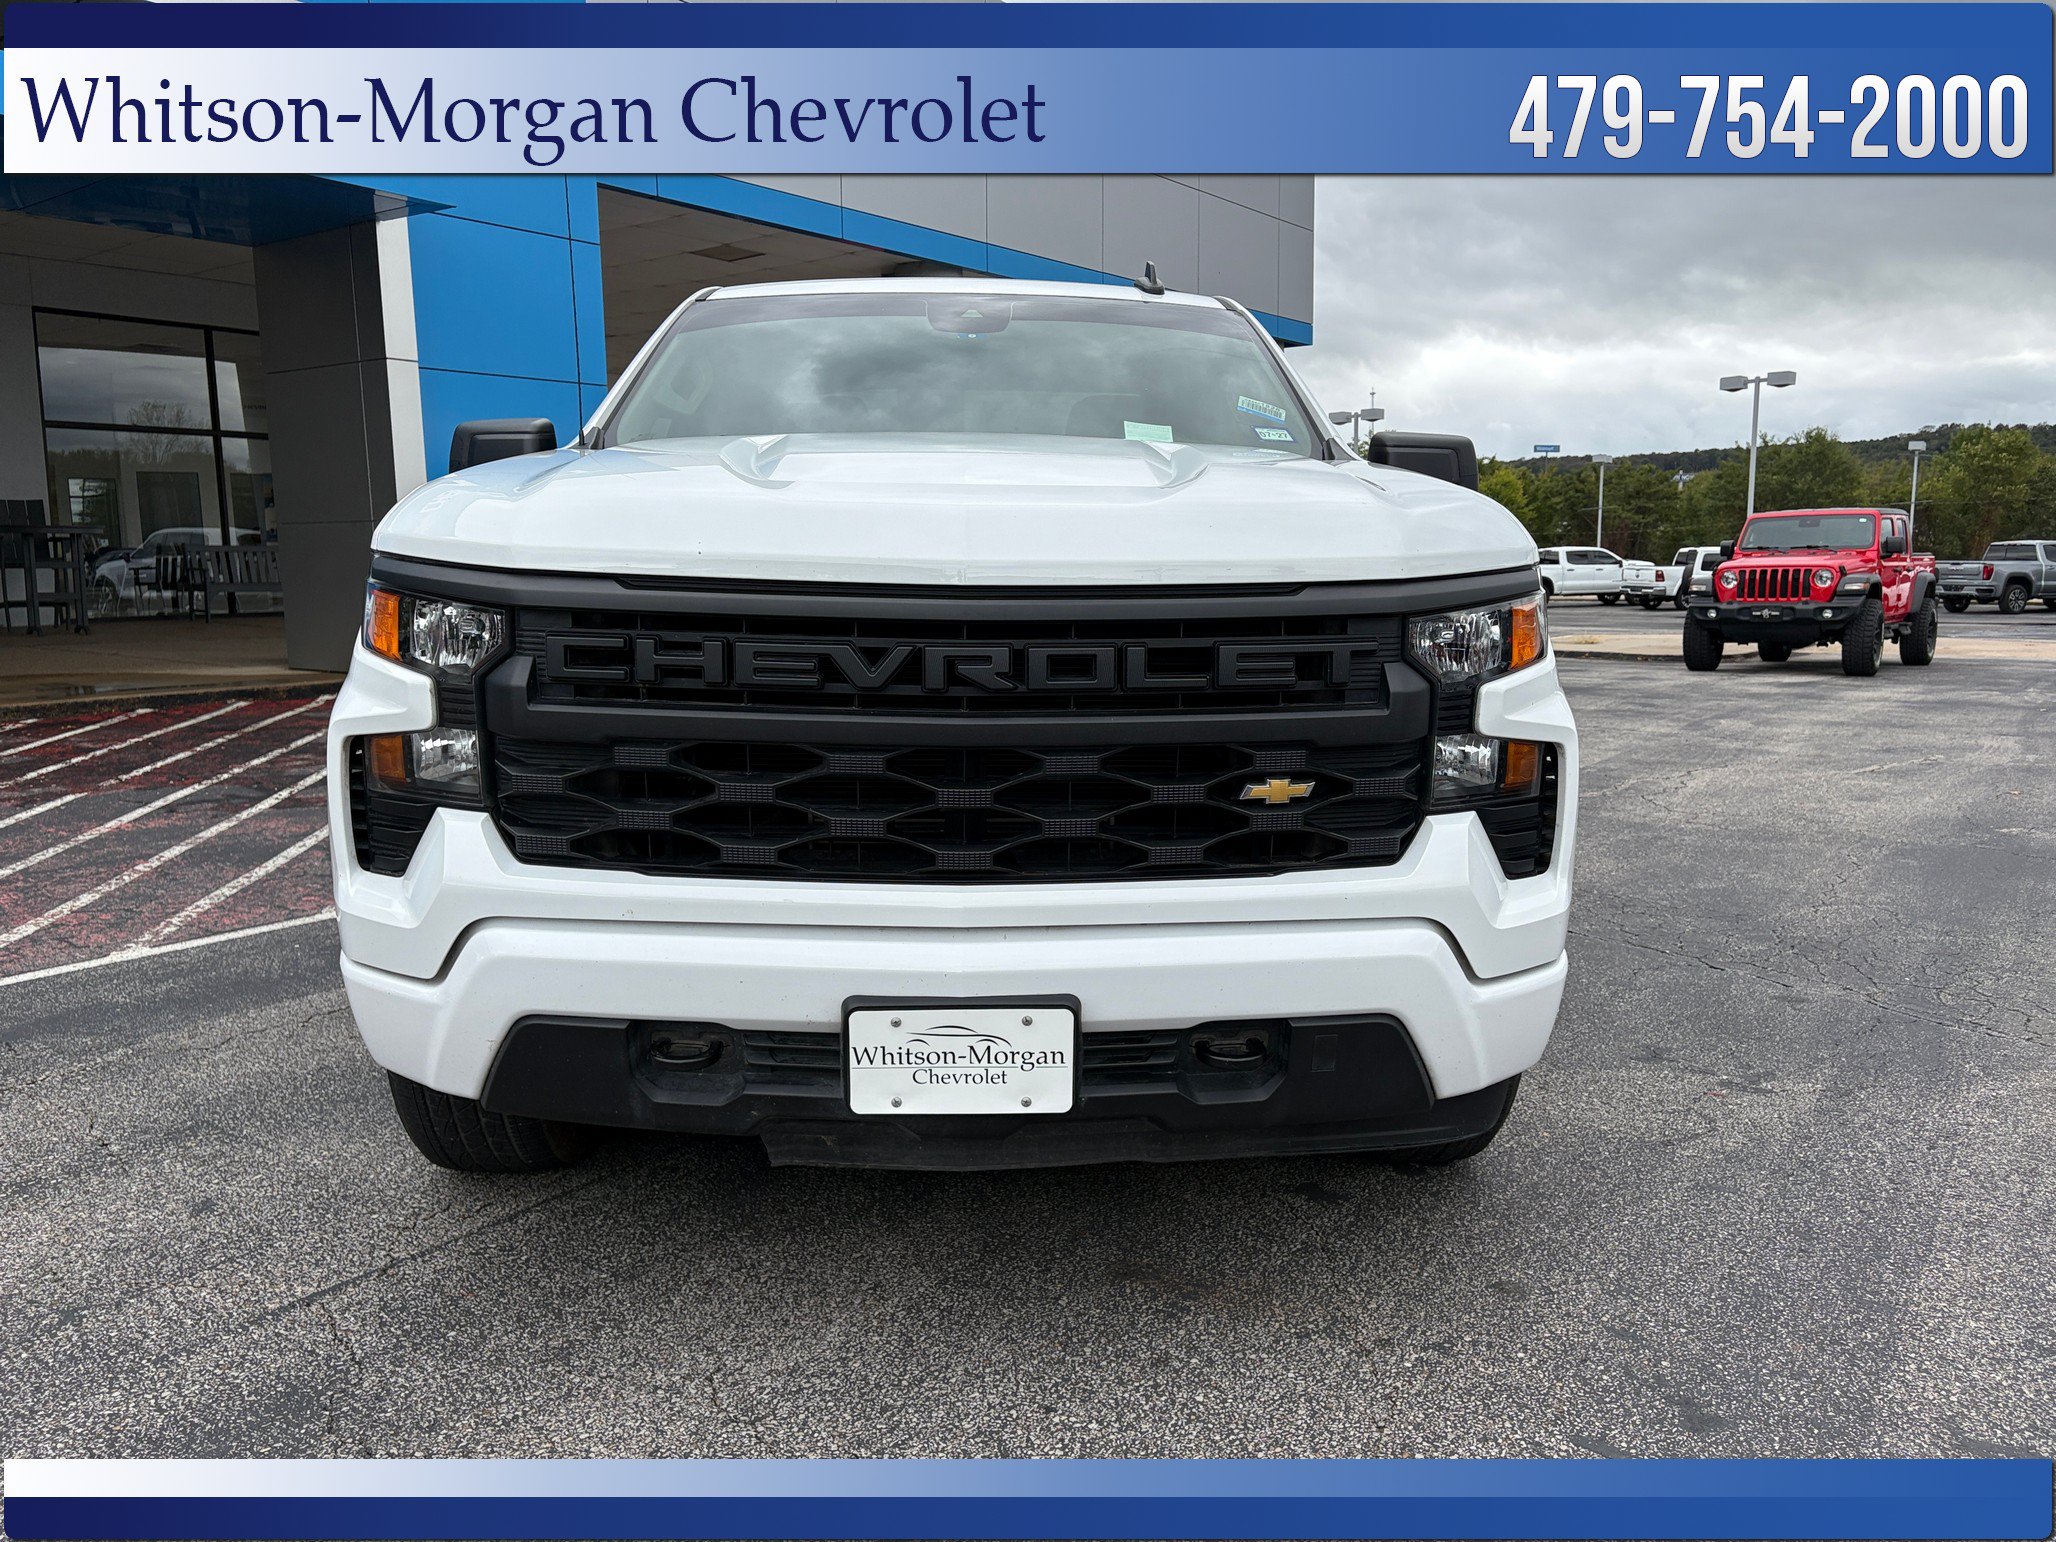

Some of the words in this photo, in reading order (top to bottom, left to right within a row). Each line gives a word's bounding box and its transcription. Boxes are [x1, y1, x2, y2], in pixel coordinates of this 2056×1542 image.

[546, 631, 1381, 691] CHEVROLET
[851, 1044, 1066, 1072] Whitson-Morgan
[912, 1068, 1008, 1085] Chevrolet
